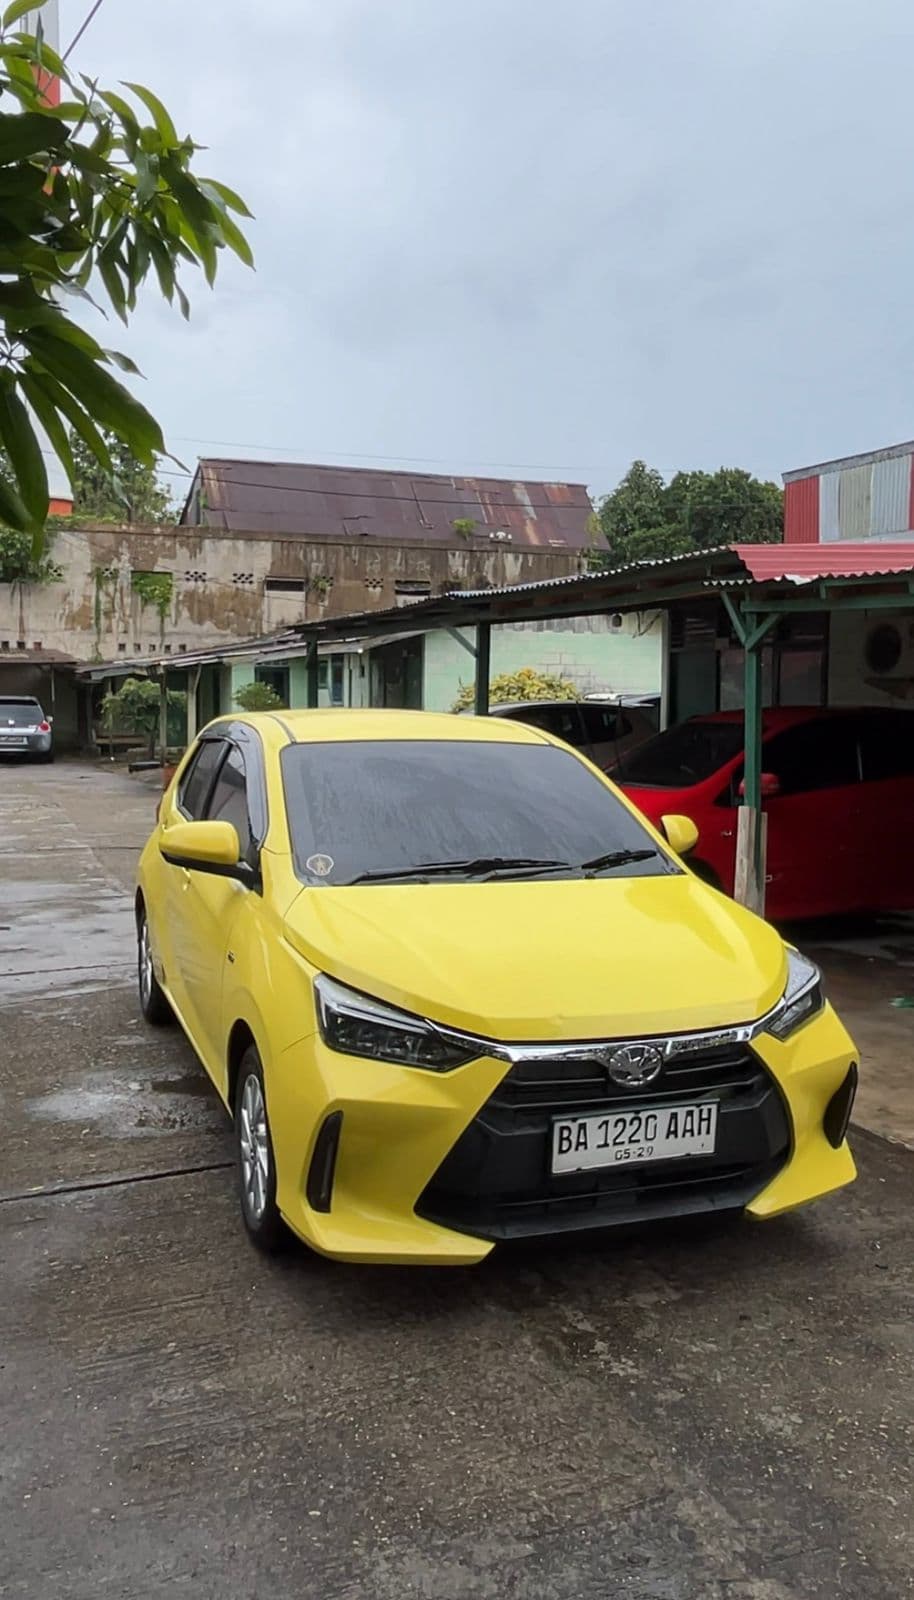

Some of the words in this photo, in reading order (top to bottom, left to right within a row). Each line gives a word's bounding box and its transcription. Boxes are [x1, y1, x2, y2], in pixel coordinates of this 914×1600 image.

[557, 1122, 588, 1155] BA
[596, 1114, 658, 1149] 1220
[665, 1107, 713, 1140] AAH
